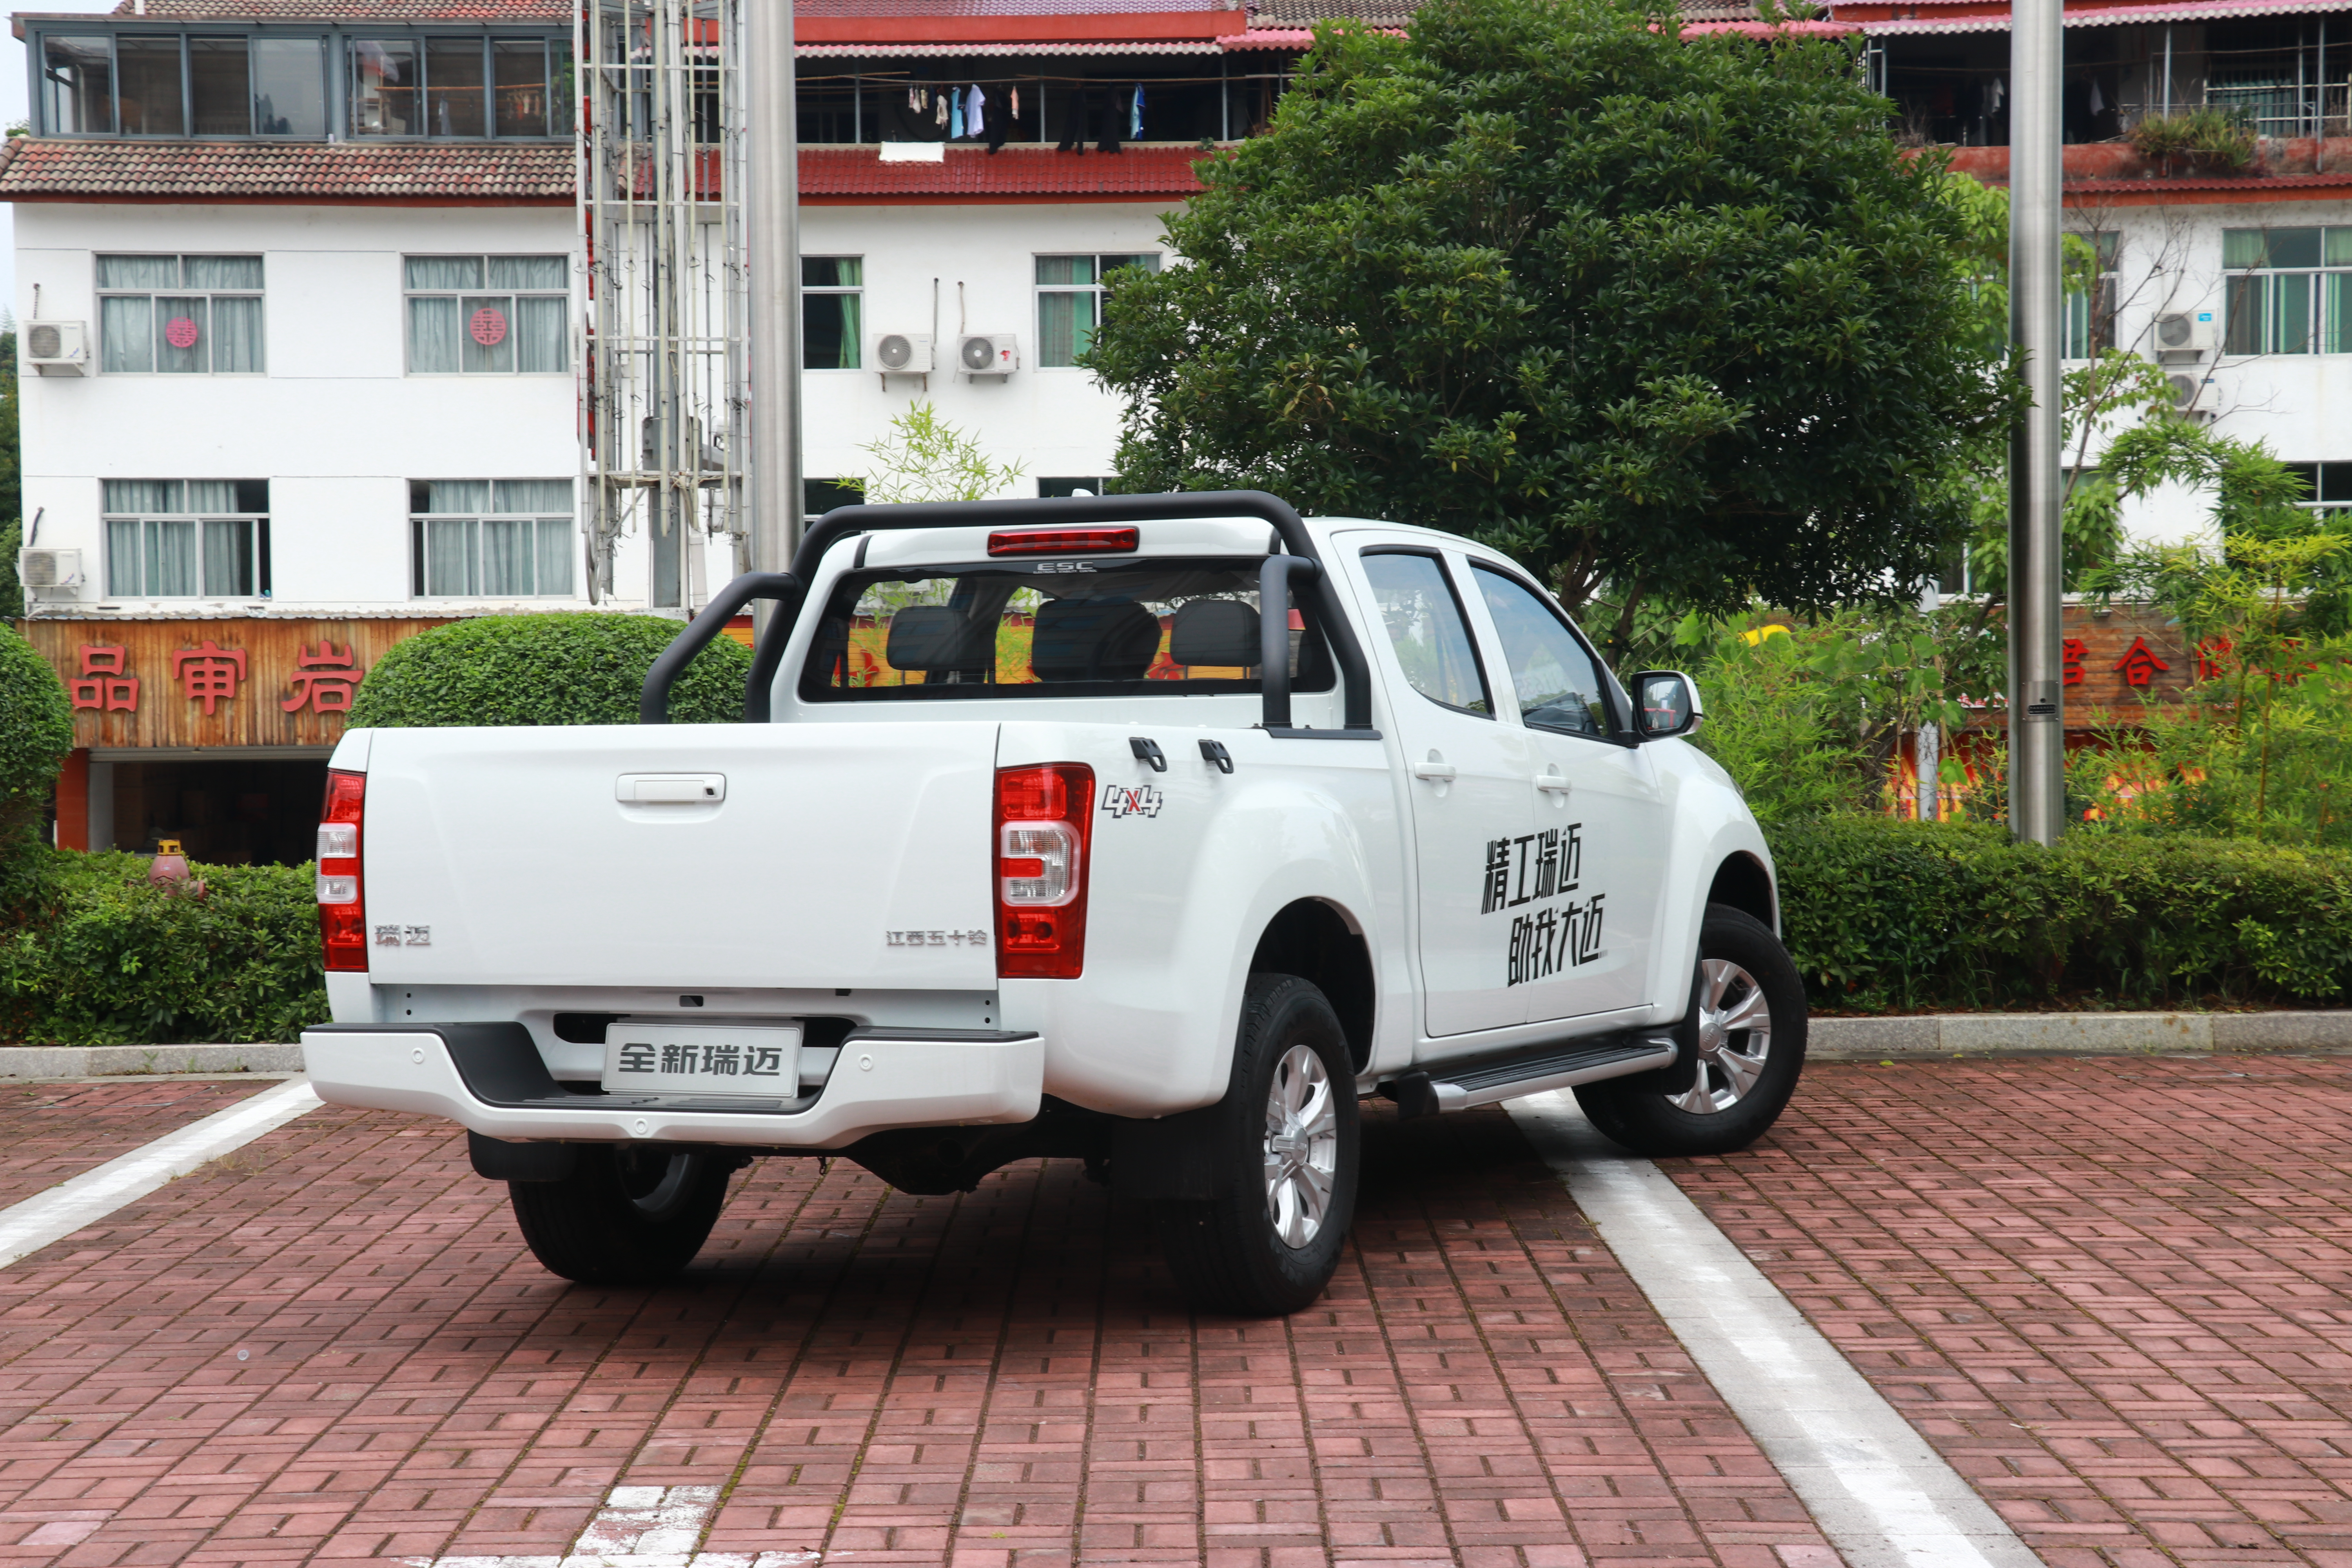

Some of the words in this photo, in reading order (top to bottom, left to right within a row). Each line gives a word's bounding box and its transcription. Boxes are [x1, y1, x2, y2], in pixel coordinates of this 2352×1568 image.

[1037, 562, 1094, 570] ESC
[1481, 822, 1582, 915] 精工瑞迈
[374, 924, 431, 946] 瑞迈
[886, 929, 987, 946] 江西五十铃
[1507, 893, 1606, 987] 助我大迈
[618, 1043, 783, 1076] 全新瑞迈
